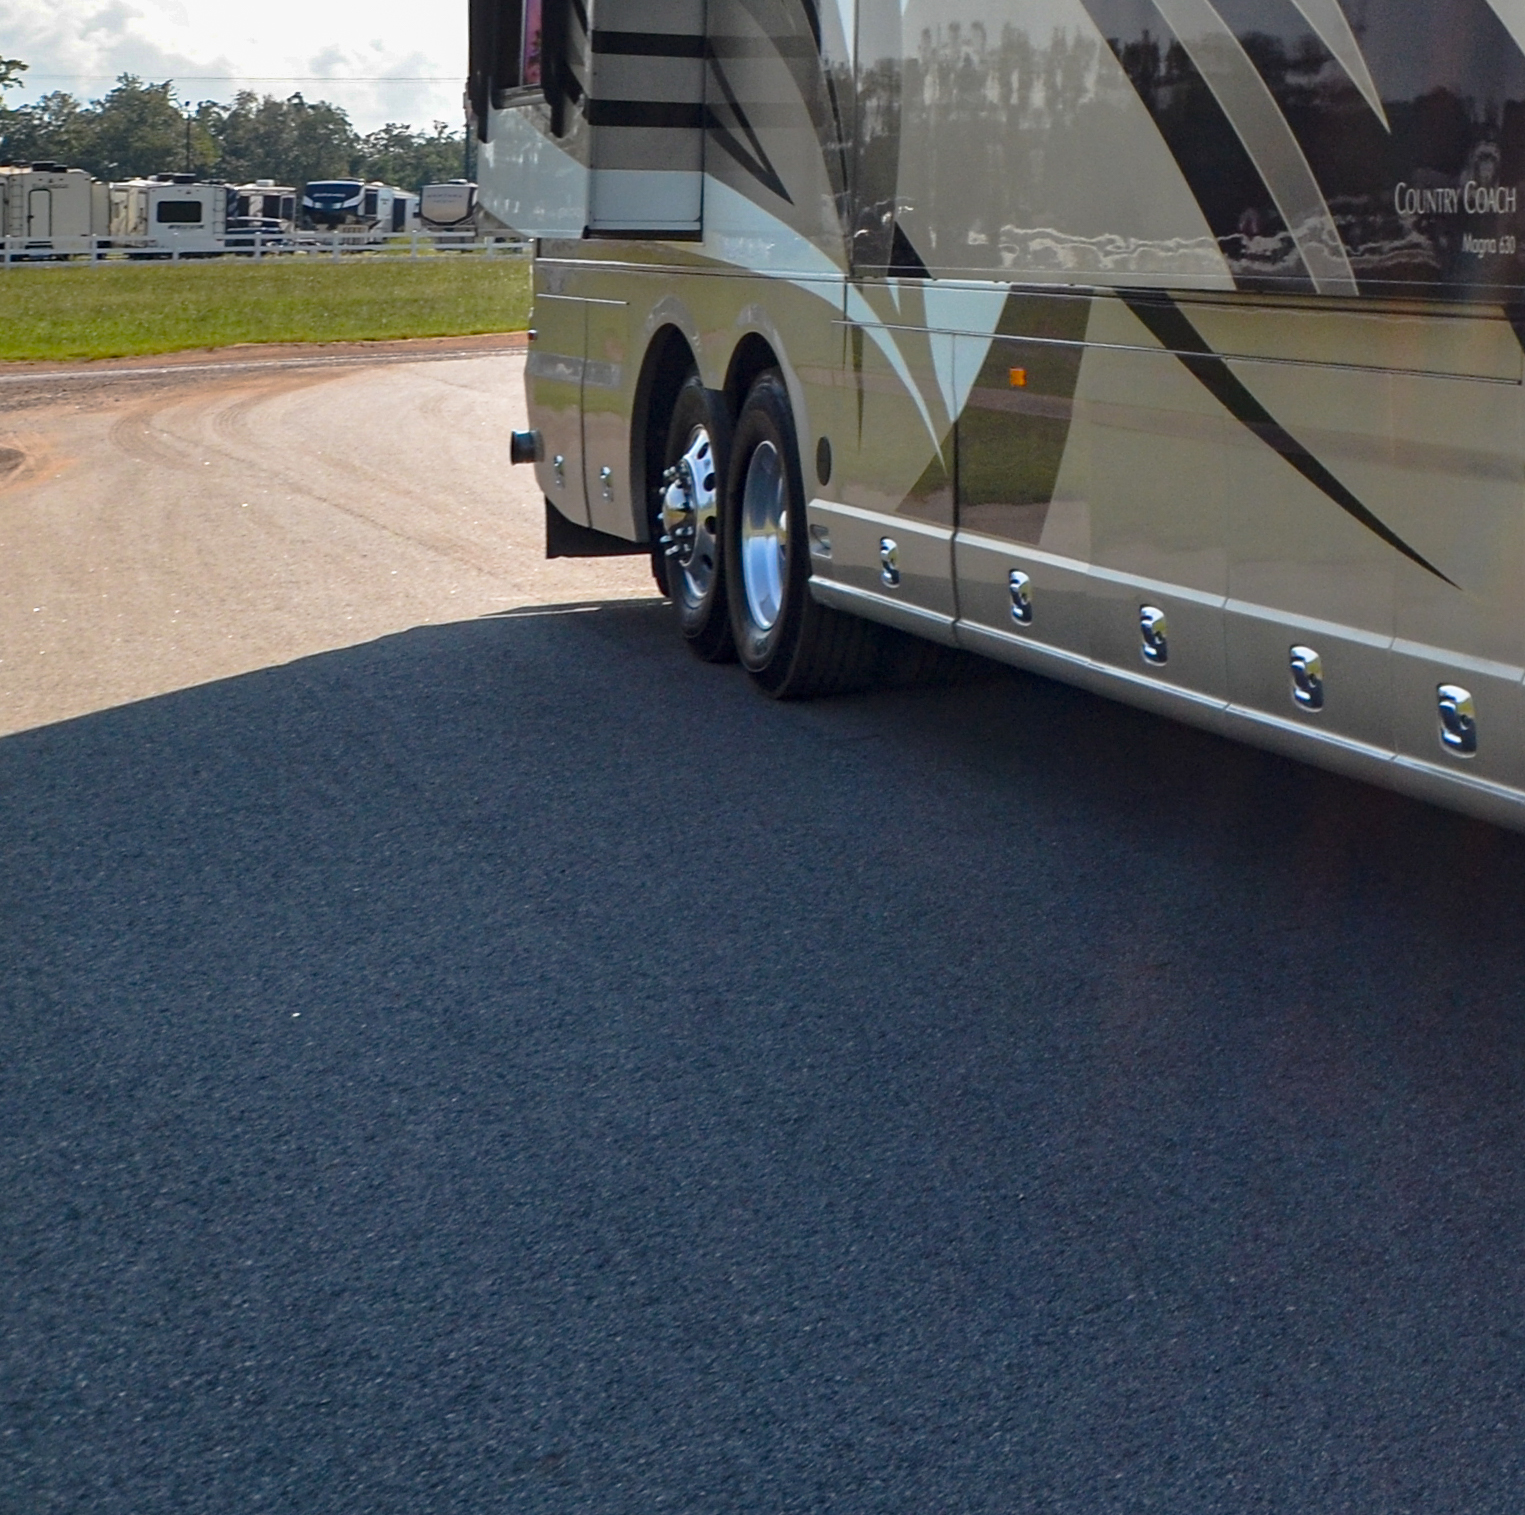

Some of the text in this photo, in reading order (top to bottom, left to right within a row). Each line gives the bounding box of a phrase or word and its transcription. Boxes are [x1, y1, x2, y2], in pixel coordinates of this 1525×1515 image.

[1394, 180, 1517, 215] COUNTRY COACH
[1462, 232, 1517, 259] Magna 630
